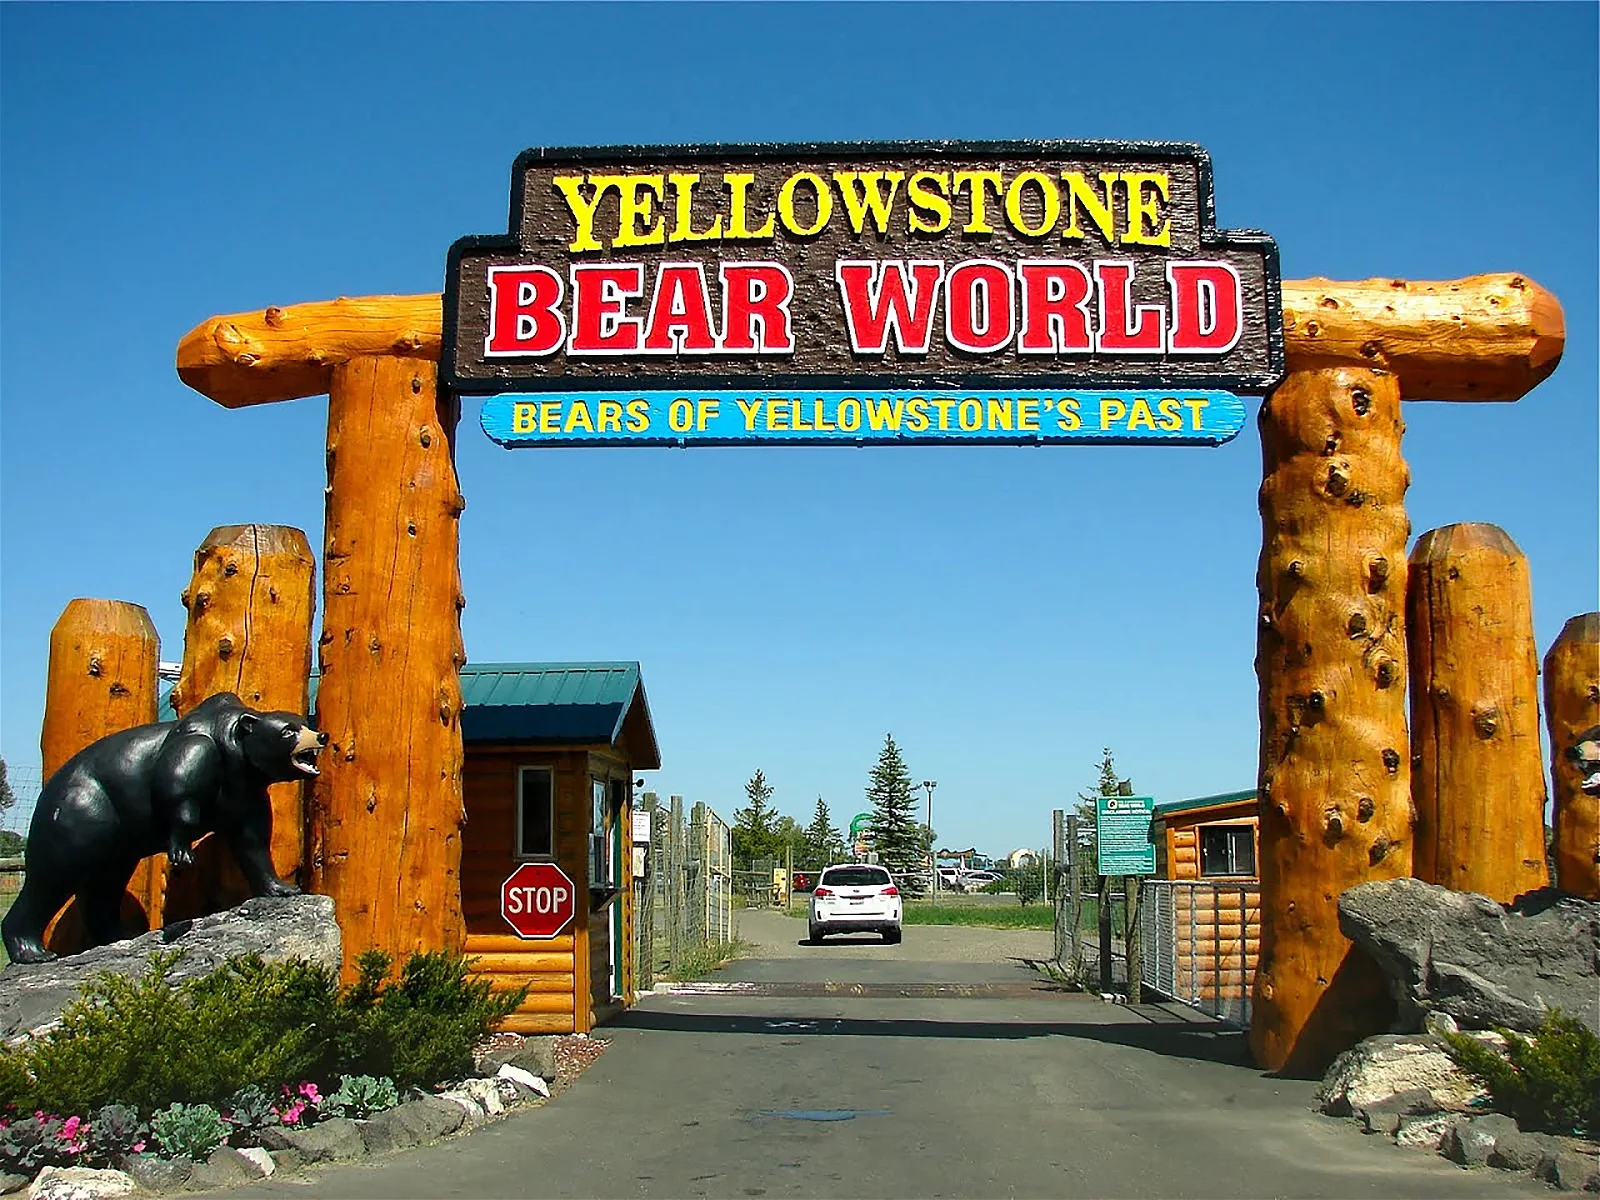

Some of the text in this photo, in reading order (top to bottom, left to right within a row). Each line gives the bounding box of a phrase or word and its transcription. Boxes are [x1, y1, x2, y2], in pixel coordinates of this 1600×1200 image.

[553, 170, 1172, 253] YELLOWSTONE
[484, 258, 1244, 358] BEAR WORLD
[513, 399, 1210, 434] BEARS OF YELLOWSTONE'S PAST
[508, 887, 568, 914] STOP
